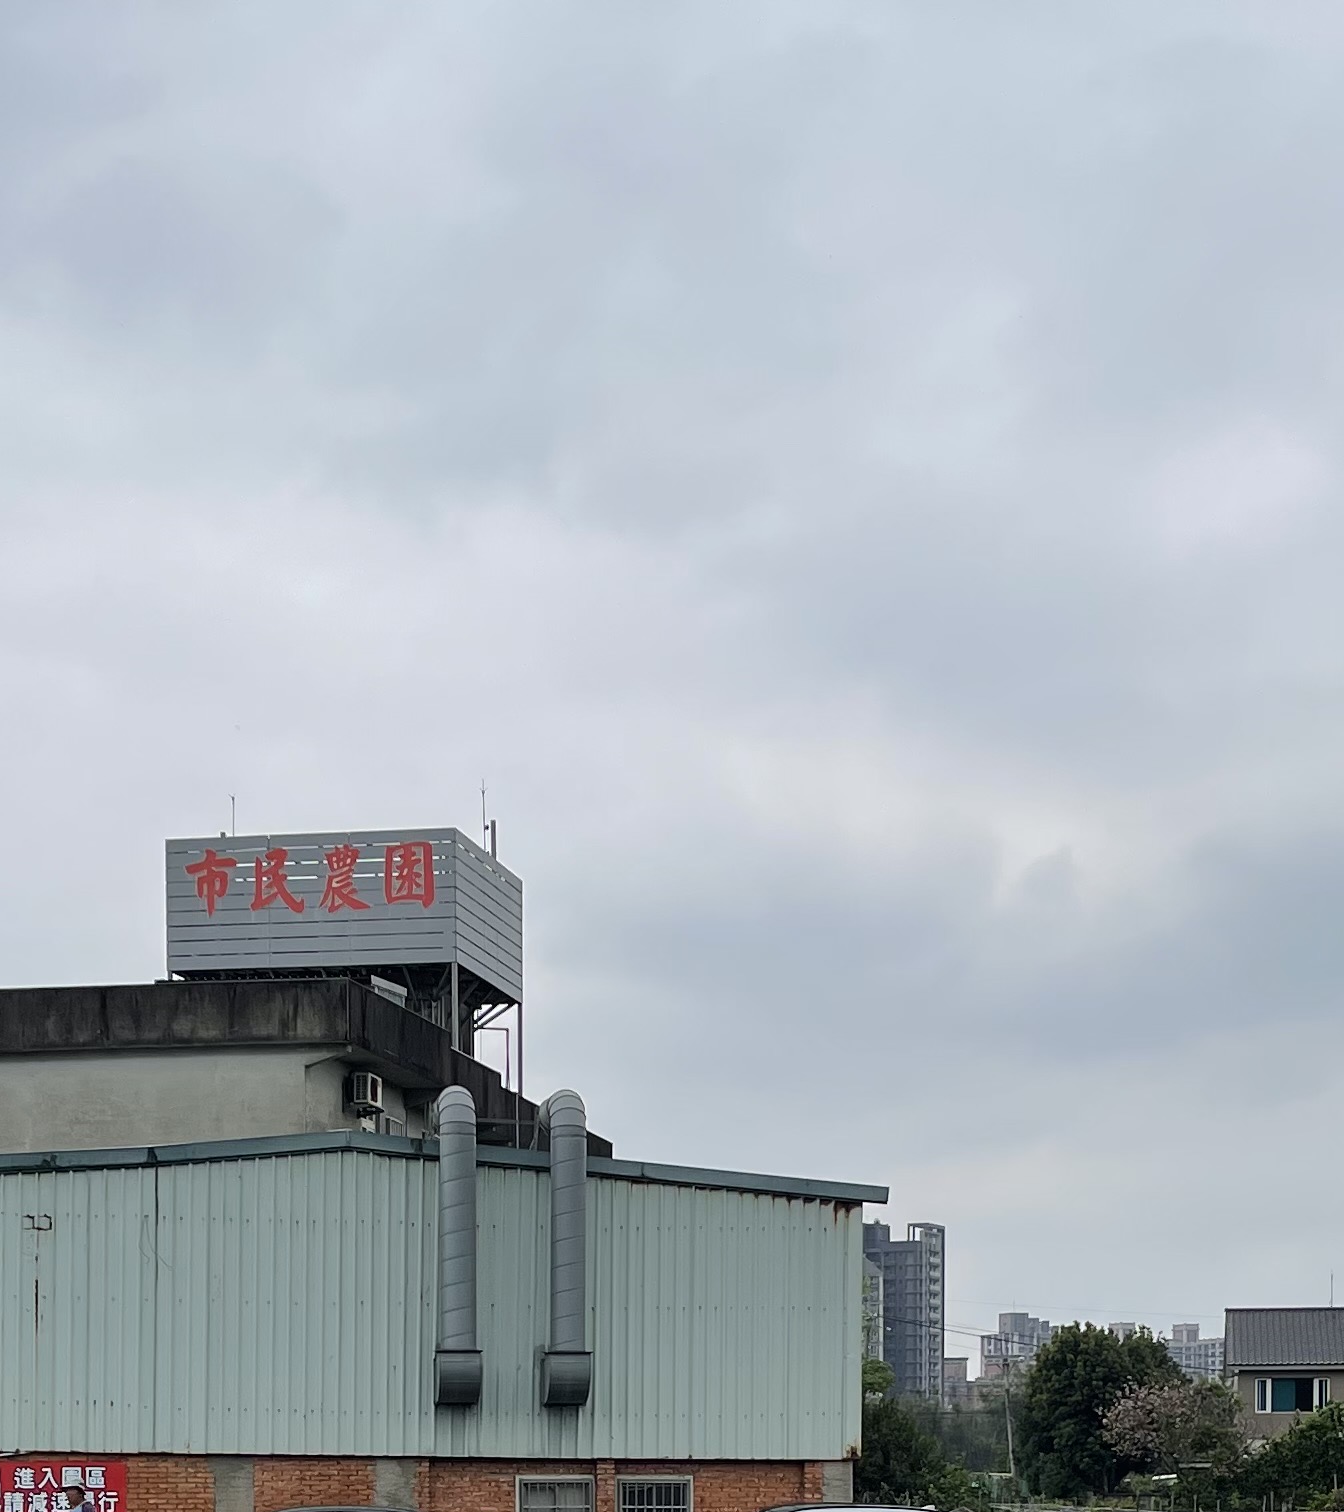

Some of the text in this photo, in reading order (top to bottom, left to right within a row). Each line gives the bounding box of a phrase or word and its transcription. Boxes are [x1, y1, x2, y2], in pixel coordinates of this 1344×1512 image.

[184, 841, 436, 917] 市民農園
[13, 1466, 107, 1489] 進入園區
